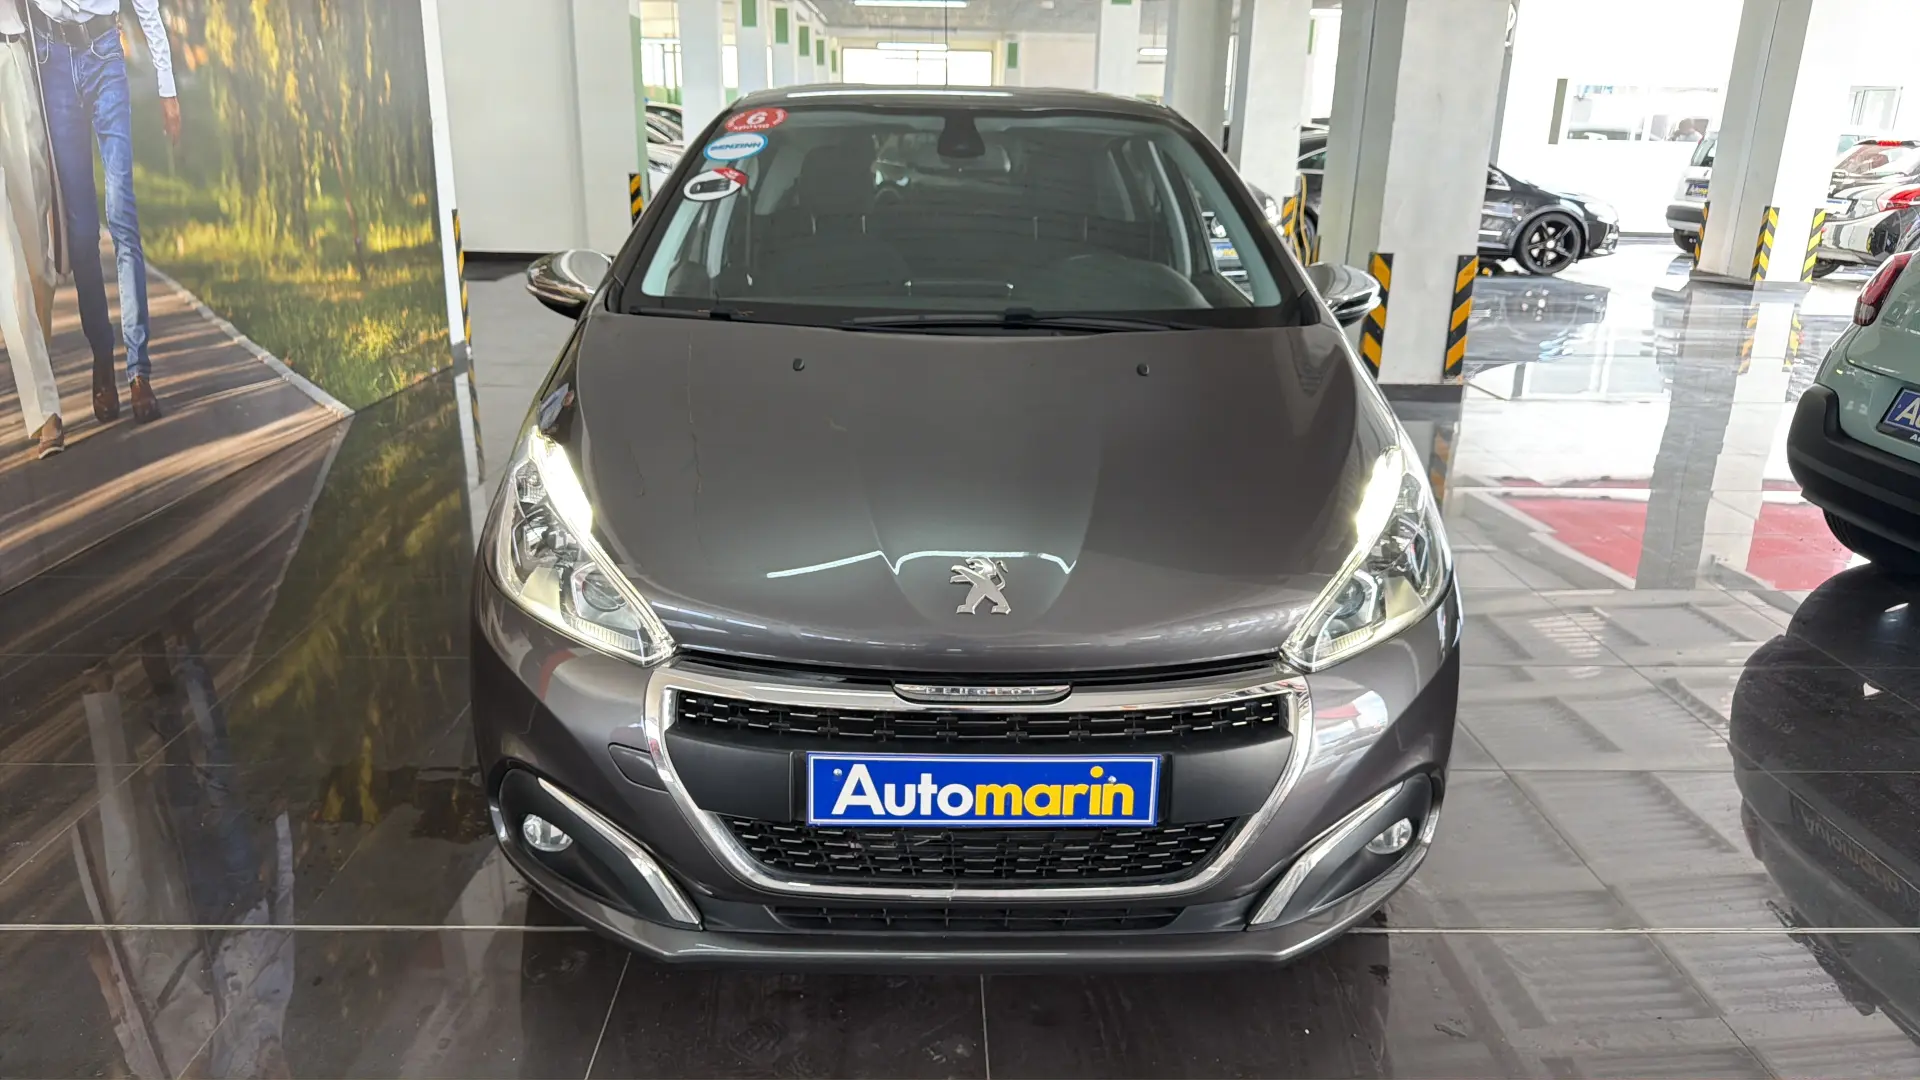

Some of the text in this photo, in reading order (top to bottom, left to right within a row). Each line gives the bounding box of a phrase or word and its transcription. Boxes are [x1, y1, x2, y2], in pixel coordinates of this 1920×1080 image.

[746, 111, 769, 125] 6
[925, 686, 1036, 696] PEUGEOT
[831, 763, 1135, 817] Automarin
